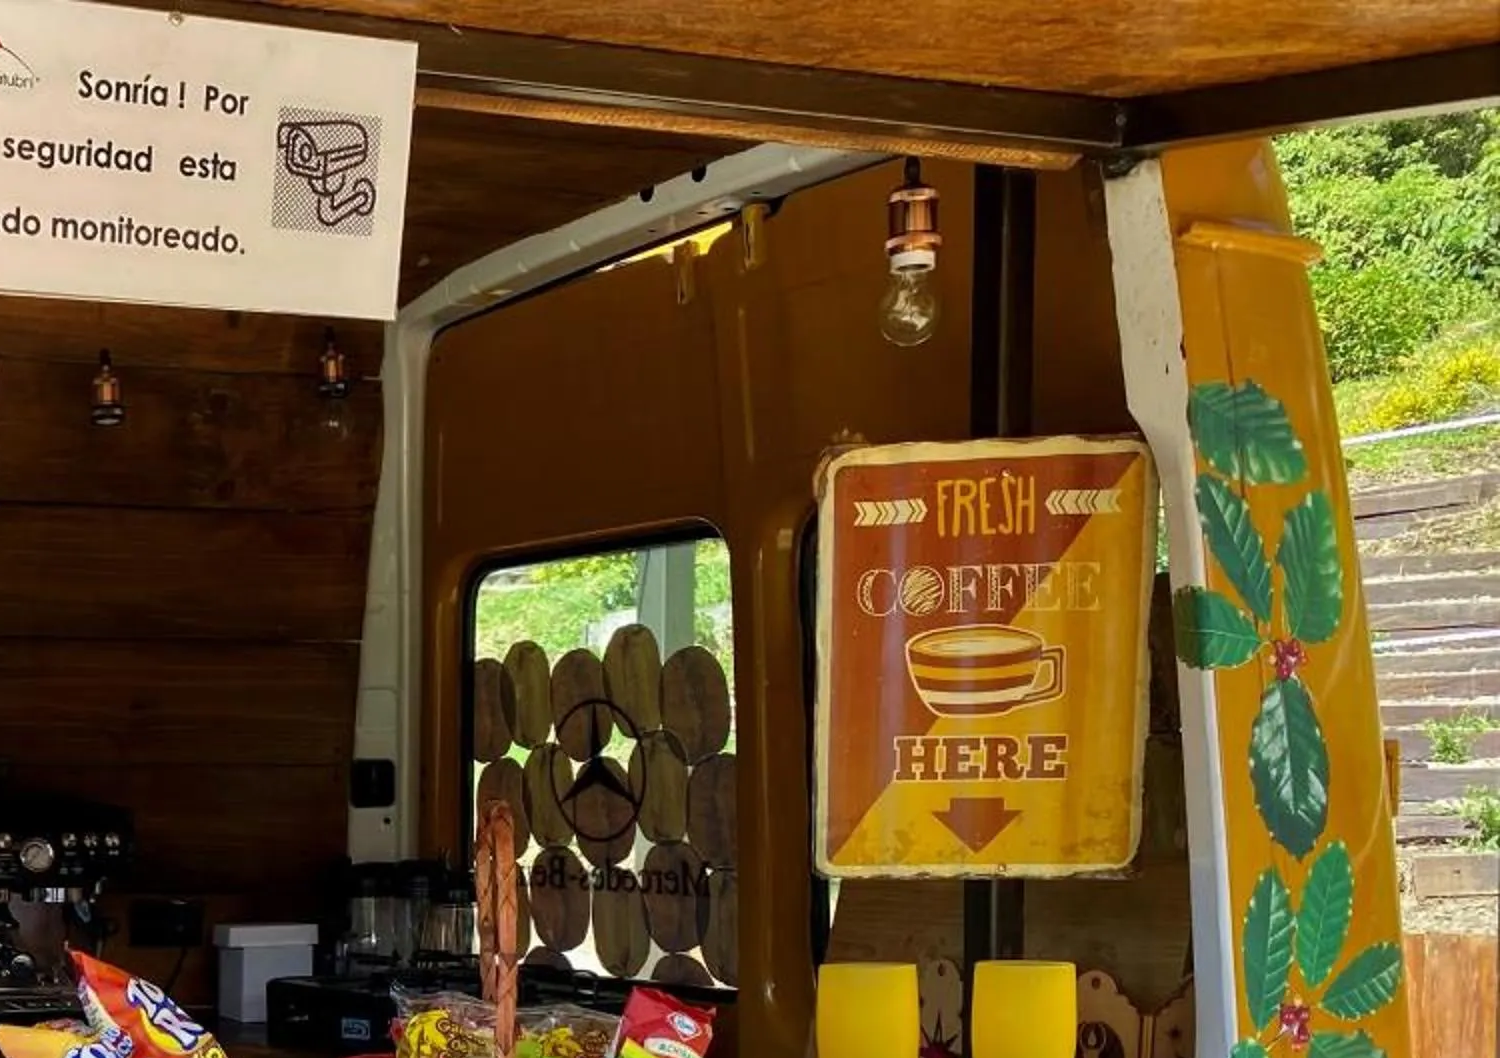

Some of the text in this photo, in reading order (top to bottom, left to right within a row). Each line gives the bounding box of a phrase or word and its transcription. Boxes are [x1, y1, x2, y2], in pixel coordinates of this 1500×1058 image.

[77, 69, 168, 109] Sonría
[203, 83, 250, 116] Por
[2, 133, 153, 174] seguridad
[178, 150, 237, 181] esta
[50, 212, 246, 255] monitoreado.
[936, 474, 1036, 538] FRESH
[856, 561, 1100, 617] COFFEE
[893, 734, 1069, 782] HERE
